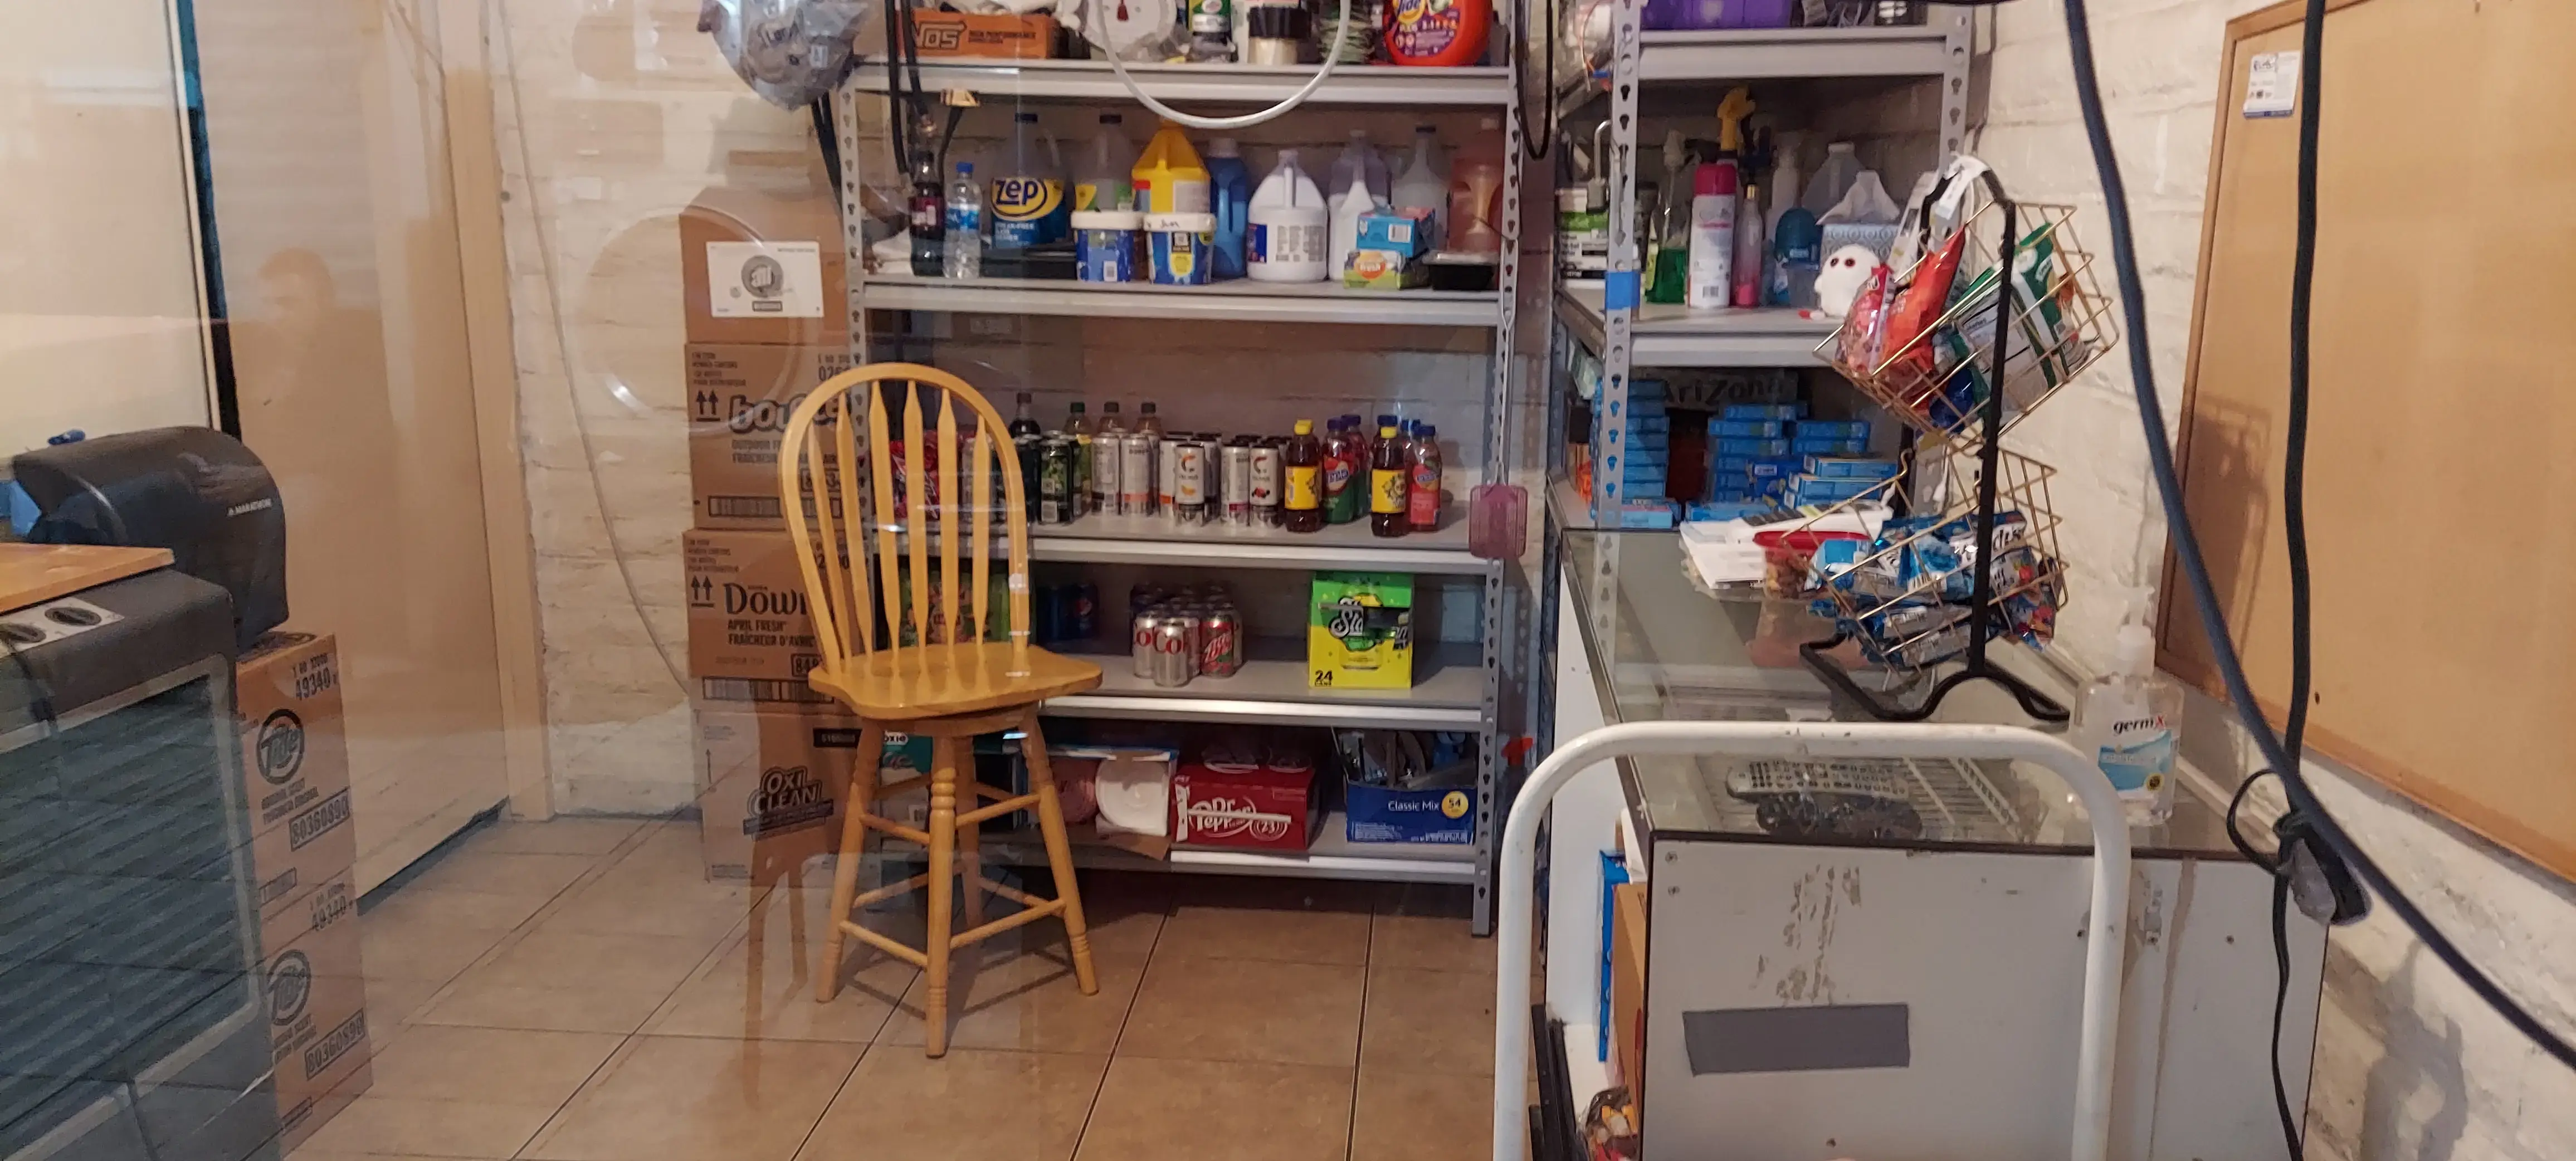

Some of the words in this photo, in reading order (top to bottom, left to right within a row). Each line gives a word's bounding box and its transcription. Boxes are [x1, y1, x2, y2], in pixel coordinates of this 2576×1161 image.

[1315, 670, 1333, 681] 24
[767, 769, 807, 796] OXI
[753, 783, 819, 813] CLEAN
[1388, 800, 1420, 812] Classic
[1422, 800, 1440, 811] Mix
